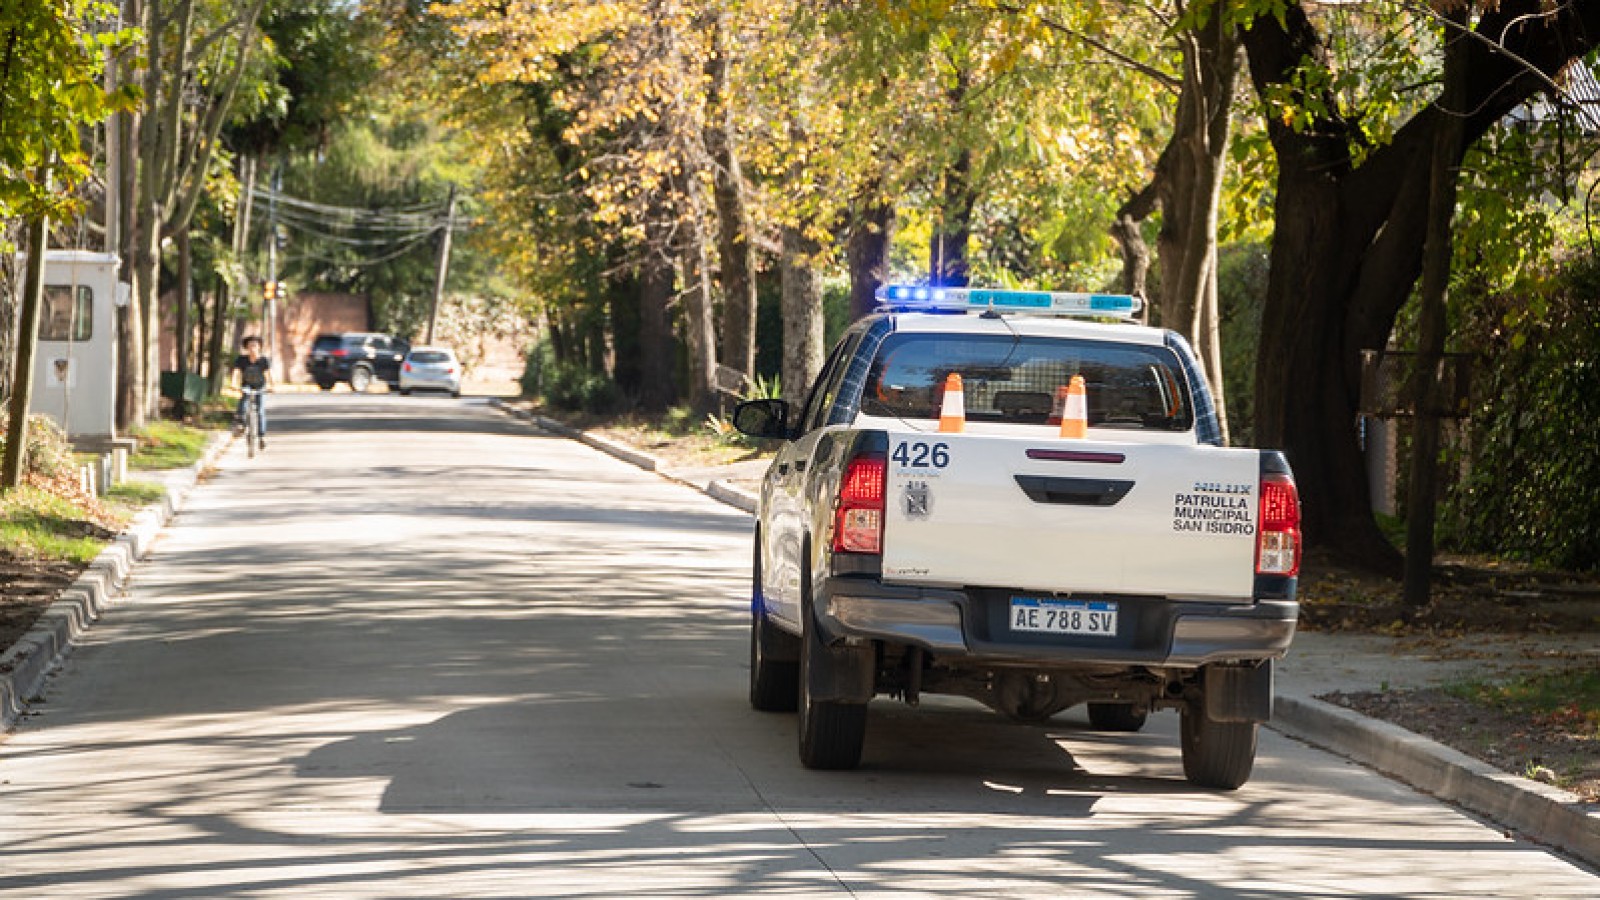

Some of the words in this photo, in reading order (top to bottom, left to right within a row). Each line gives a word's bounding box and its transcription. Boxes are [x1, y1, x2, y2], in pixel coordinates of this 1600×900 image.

[892, 441, 949, 468] 426
[1174, 494, 1247, 509] PATRULLA
[1174, 507, 1252, 521] MUNICIPAL
[1173, 519, 1202, 532] SAN
[1206, 521, 1254, 535] ISIDRO
[1016, 608, 1040, 628] AE
[1046, 610, 1081, 630] 788
[1088, 612, 1112, 632] SV
